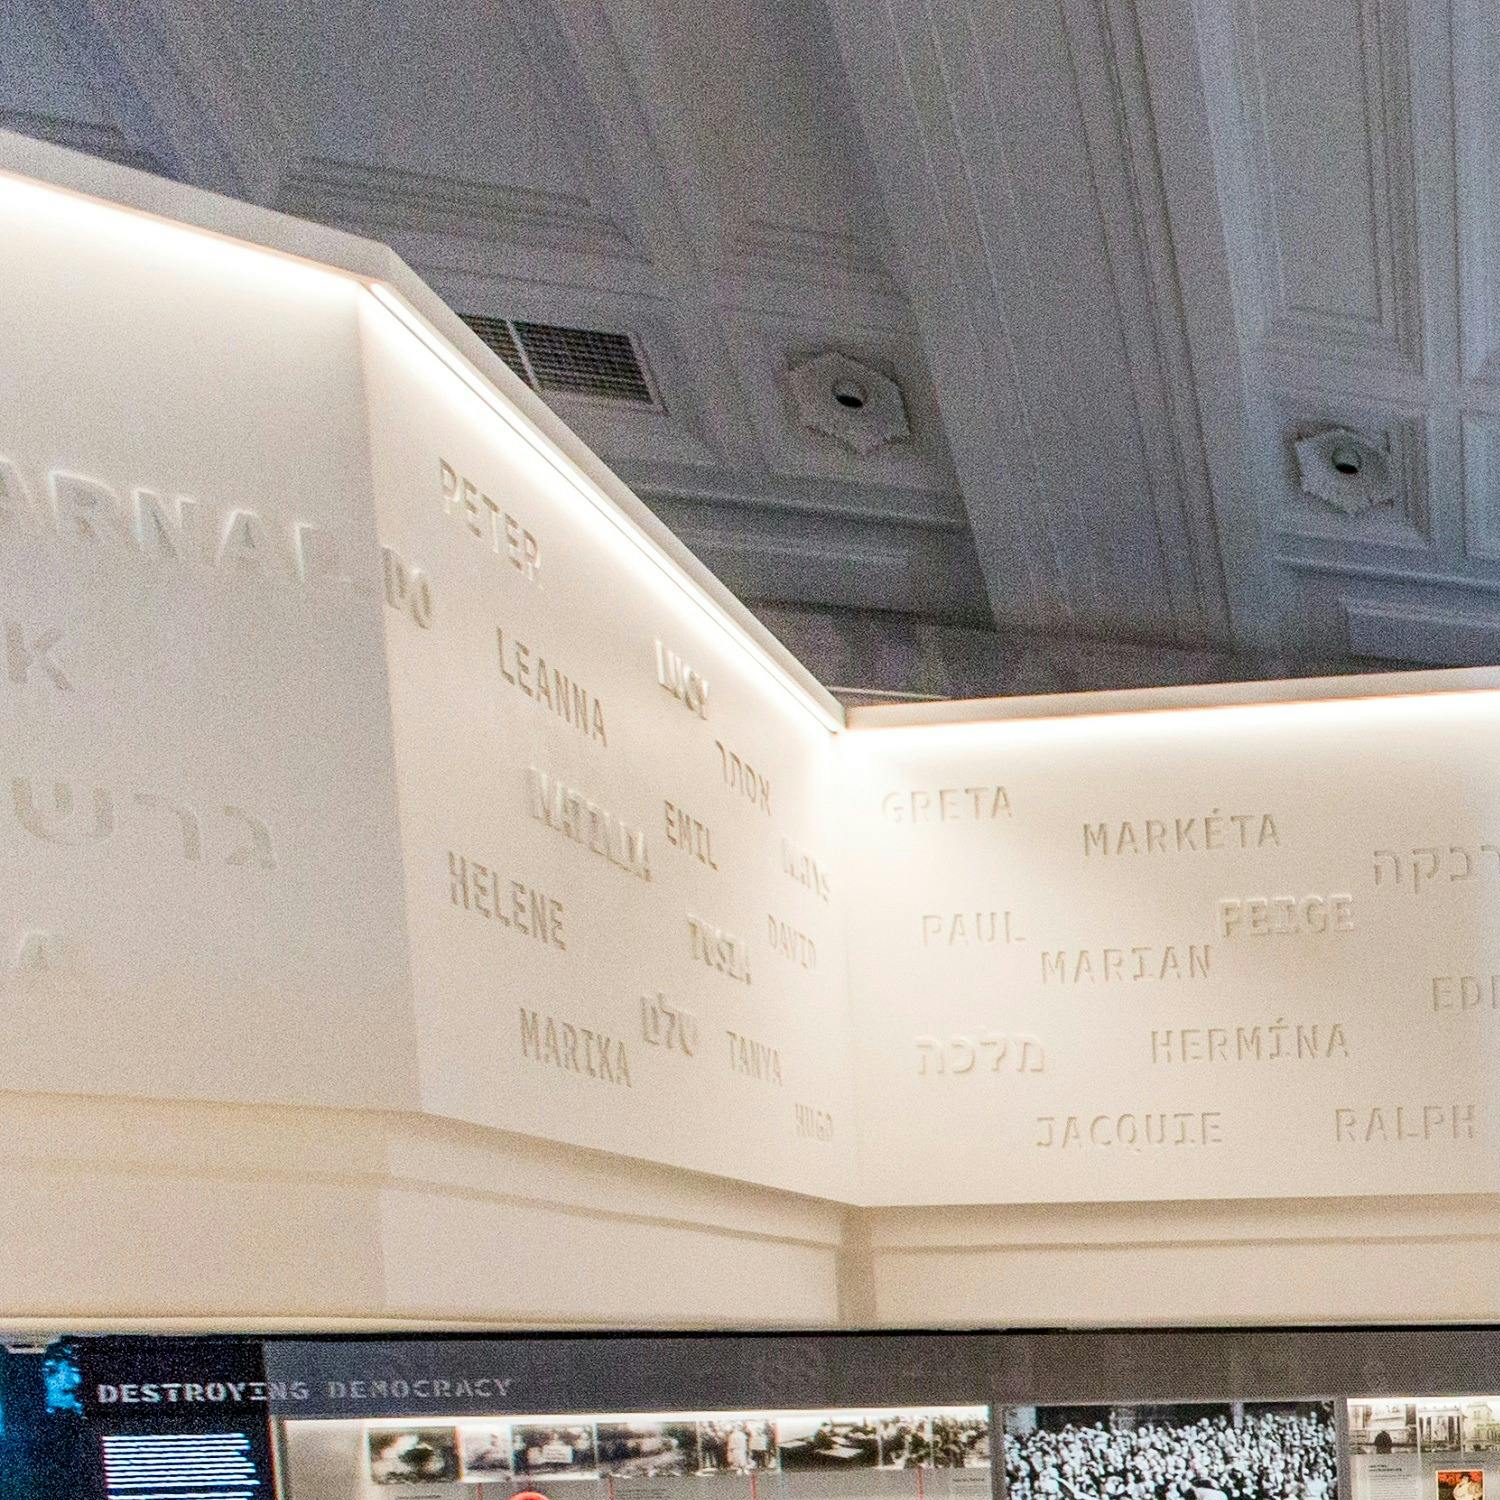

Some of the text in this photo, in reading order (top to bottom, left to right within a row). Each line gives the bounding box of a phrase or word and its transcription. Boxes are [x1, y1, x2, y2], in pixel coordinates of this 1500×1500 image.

[439, 457, 544, 588] PETER
[495, 626, 609, 748] LEANNA
[880, 785, 1014, 825] GRETA
[663, 800, 719, 872] EMIL
[1081, 807, 1283, 857] MARKÉTA
[446, 850, 567, 951] HELENE
[919, 910, 1028, 948] PAUL
[1039, 943, 1215, 986] MARIAN
[517, 1005, 633, 1089] MARIKA
[725, 1030, 783, 1087] TANYA
[1149, 1016, 1352, 1065] HERMÍNA
[1034, 1111, 1224, 1152] JACQUIE
[1334, 1104, 1478, 1144] RALPH
[97, 1377, 514, 1404] DESTROYING DEMOCRACY
